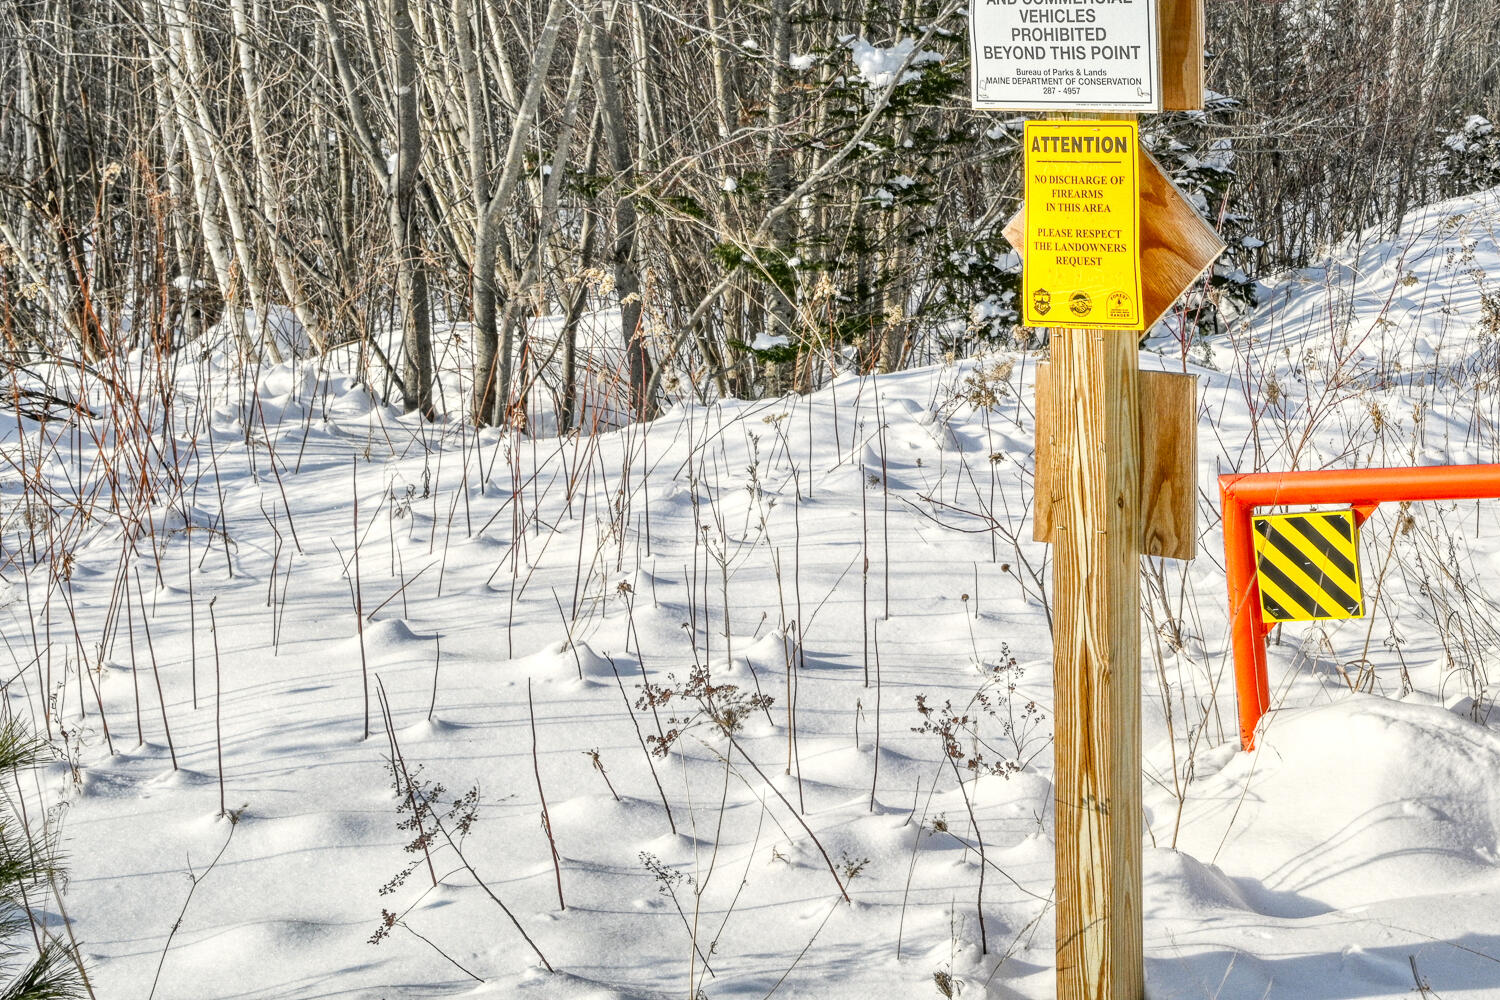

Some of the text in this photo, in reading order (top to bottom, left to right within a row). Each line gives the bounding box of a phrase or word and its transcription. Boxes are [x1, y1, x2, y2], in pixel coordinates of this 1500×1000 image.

[1019, 9, 1096, 23] VEHICLES
[1011, 27, 1107, 41] PROHIBITED
[984, 46, 1140, 60] BEYOND THIS POINT
[1016, 68, 1042, 76] Bureau
[1043, 68, 1051, 76] of
[1053, 68, 1074, 76] Parks
[986, 77, 1142, 86] MAINE DEPARTMENT OF CONSERVATION
[1043, 87, 1056, 95] 287
[1063, 87, 1081, 95] 4957
[1031, 136, 1128, 153] ATTENTION
[1034, 174, 1125, 185] NO DISCHARGE OF
[1052, 189, 1104, 199] FIREARMS
[1046, 203, 1111, 213] IN THIS AREA
[1037, 228, 1122, 239] PLEASE RESPECT
[1034, 241, 1127, 253] THE LANDOWNERS
[1056, 256, 1103, 266] REQUEST
